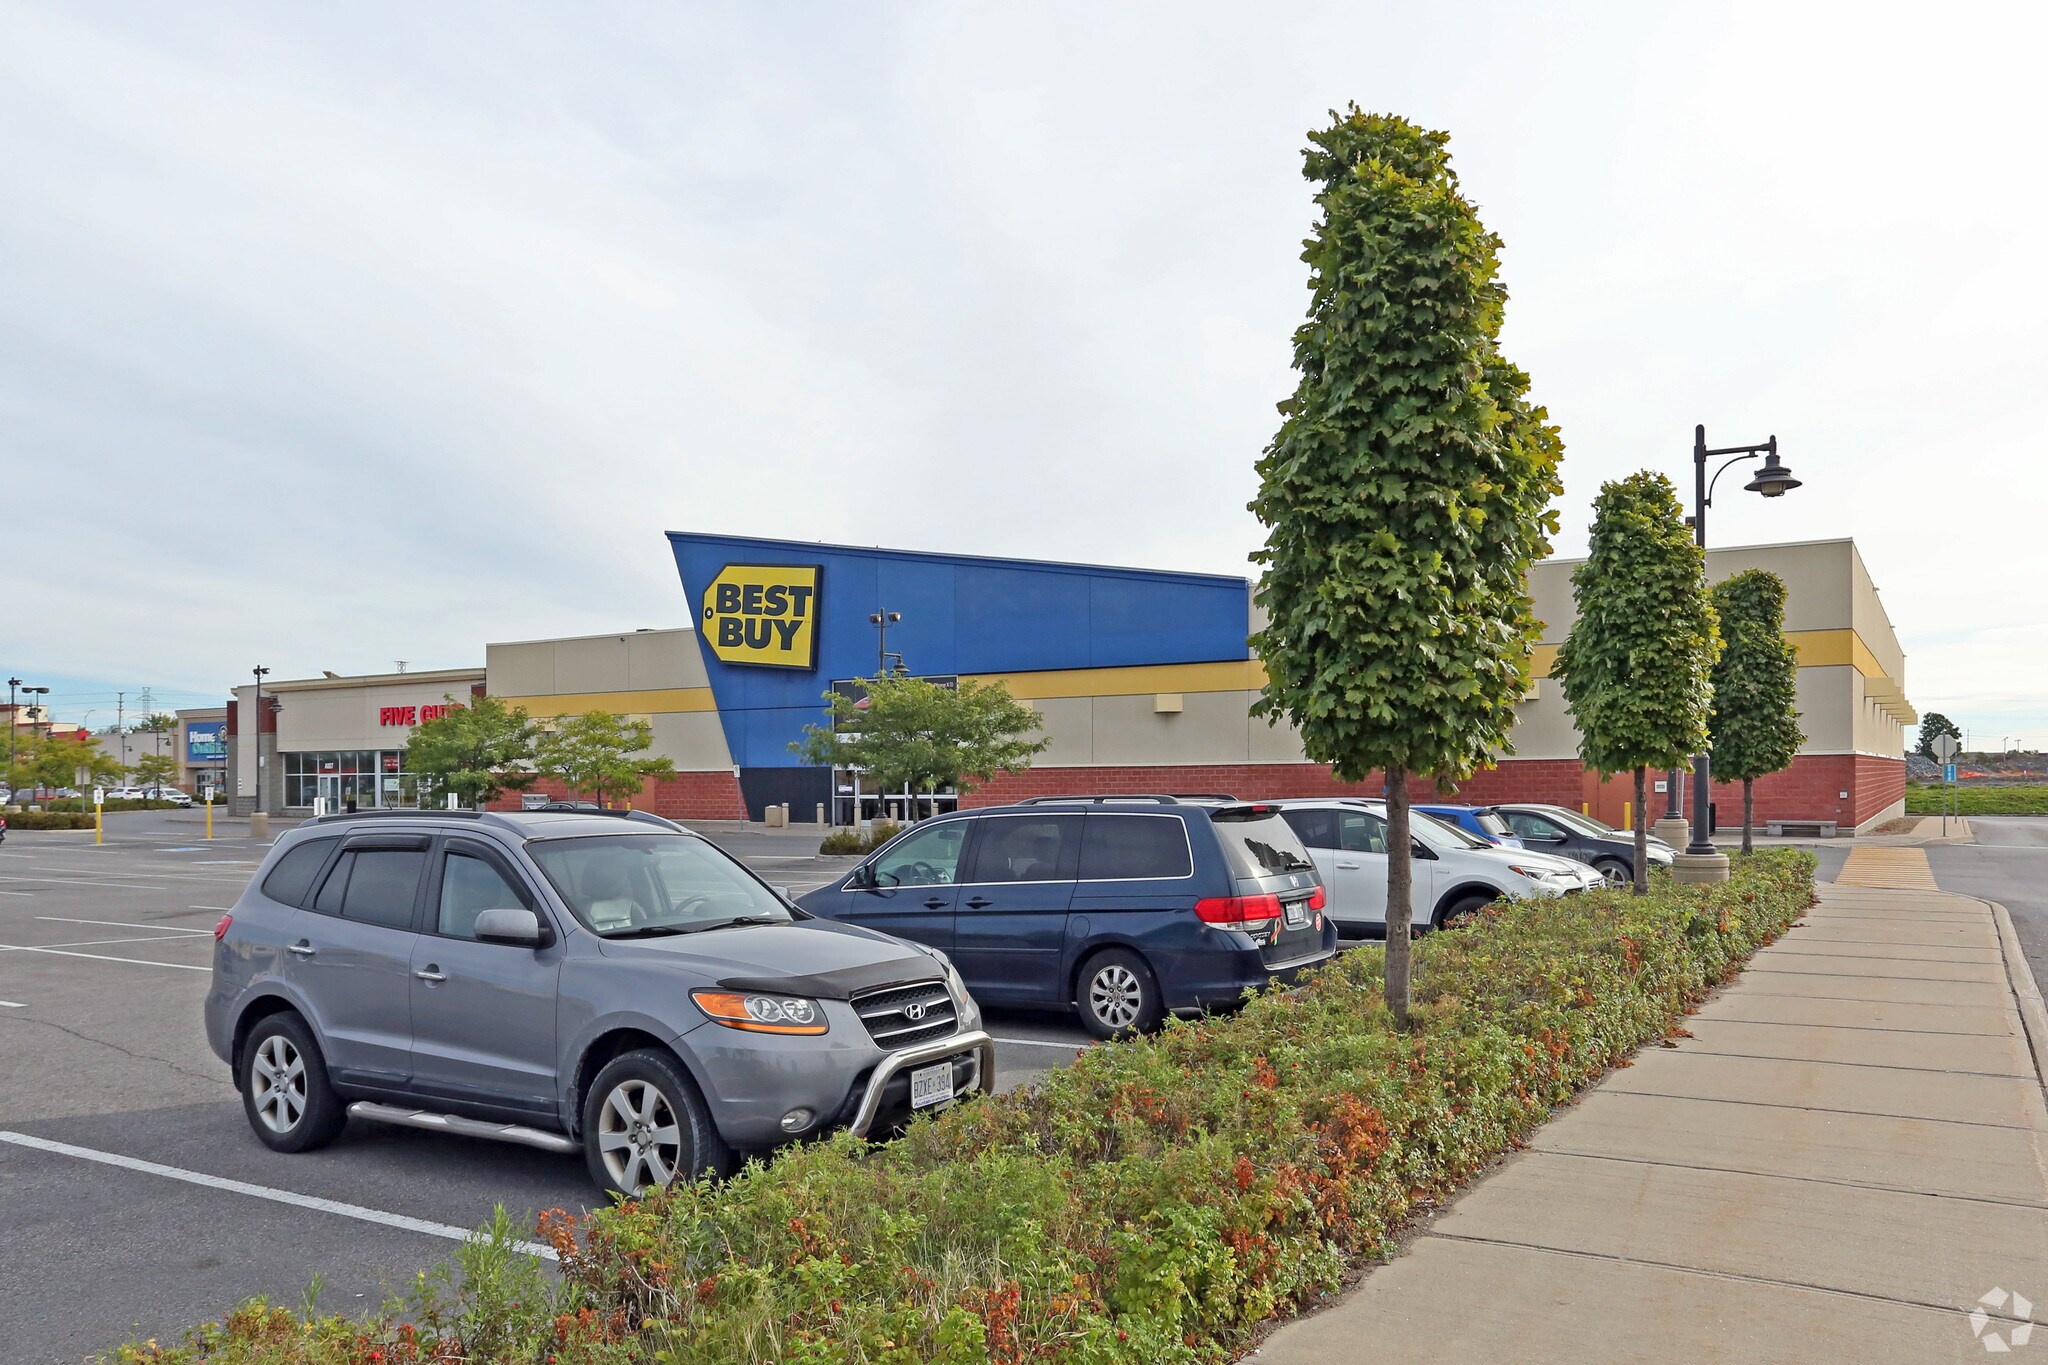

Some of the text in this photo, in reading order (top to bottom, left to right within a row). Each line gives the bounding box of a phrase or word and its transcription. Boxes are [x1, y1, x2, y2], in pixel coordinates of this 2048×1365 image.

[716, 583, 812, 617] BEST
[718, 616, 803, 651] BUY
[380, 706, 416, 726] FIVE
[190, 731, 216, 743] Home
